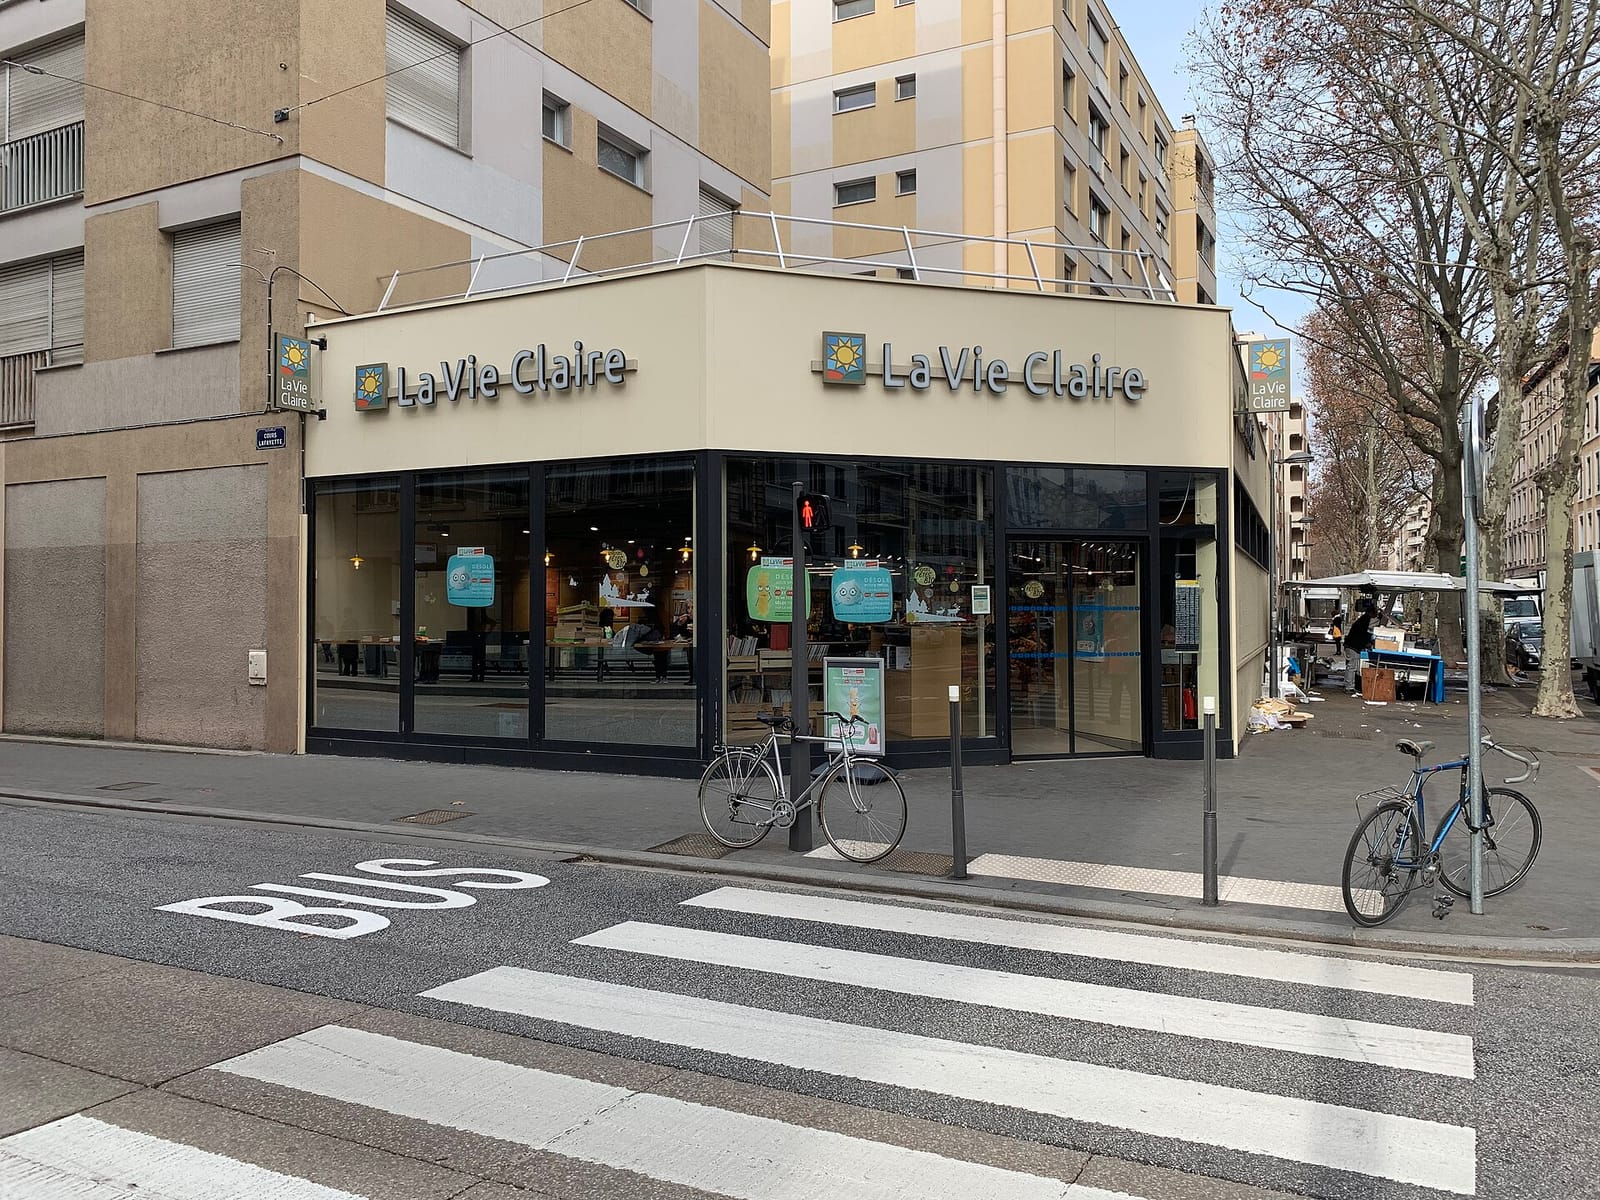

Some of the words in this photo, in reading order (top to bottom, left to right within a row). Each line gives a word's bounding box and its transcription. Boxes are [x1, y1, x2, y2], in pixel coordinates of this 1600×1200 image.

[397, 366, 437, 408] La
[440, 354, 499, 401] Vie
[511, 340, 626, 394] Claire
[882, 343, 931, 390] La
[938, 345, 1009, 394] Vie
[1023, 349, 1144, 401] Claire
[281, 378, 292, 391] La
[292, 380, 307, 394] Vie
[1252, 383, 1266, 395] La
[1266, 381, 1286, 394] Vie
[281, 392, 307, 408] Claire
[1253, 396, 1286, 409] Claire
[258, 438, 283, 446] LAFAYETTE
[153, 858, 551, 940] BUS
